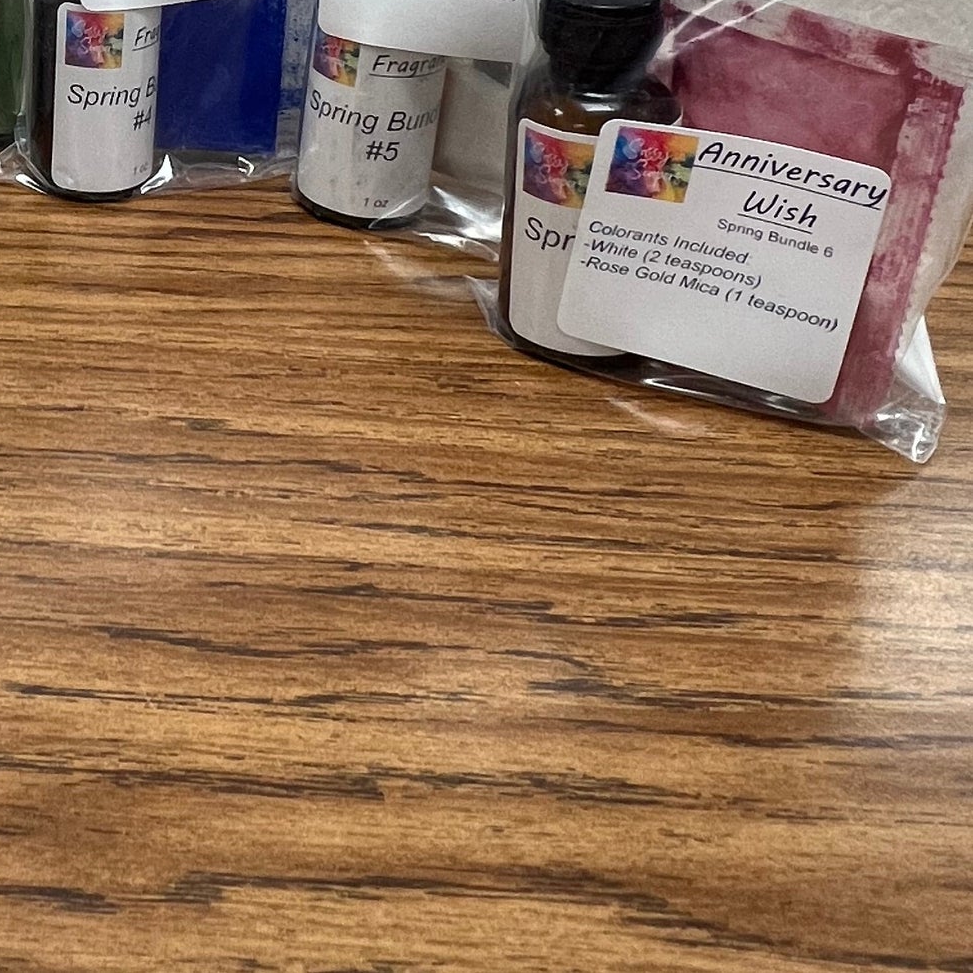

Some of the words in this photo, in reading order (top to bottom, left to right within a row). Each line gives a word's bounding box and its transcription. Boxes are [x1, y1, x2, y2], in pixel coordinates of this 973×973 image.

[372, 54, 444, 77] Fragra
[67, 84, 141, 109] Spring
[310, 89, 379, 134] Spring
[387, 108, 438, 132] Bund
[365, 140, 400, 162] #5
[697, 141, 887, 208] Anniversary
[363, 197, 369, 207] 1
[374, 199, 389, 208] oz
[743, 189, 818, 228] Wish
[525, 216, 576, 251] Spr
[588, 220, 669, 247] Colorants
[717, 218, 764, 241] Spring
[768, 230, 819, 255] Bundle
[823, 245, 833, 258] 6
[583, 238, 639, 259] -White
[642, 247, 661, 264] (2
[664, 252, 763, 290] teaspoons)
[580, 256, 629, 276] -Rose
[635, 266, 676, 285] Gold
[679, 276, 720, 297] Mica
[725, 287, 742, 303] (1
[748, 291, 839, 333] teaspoon)
